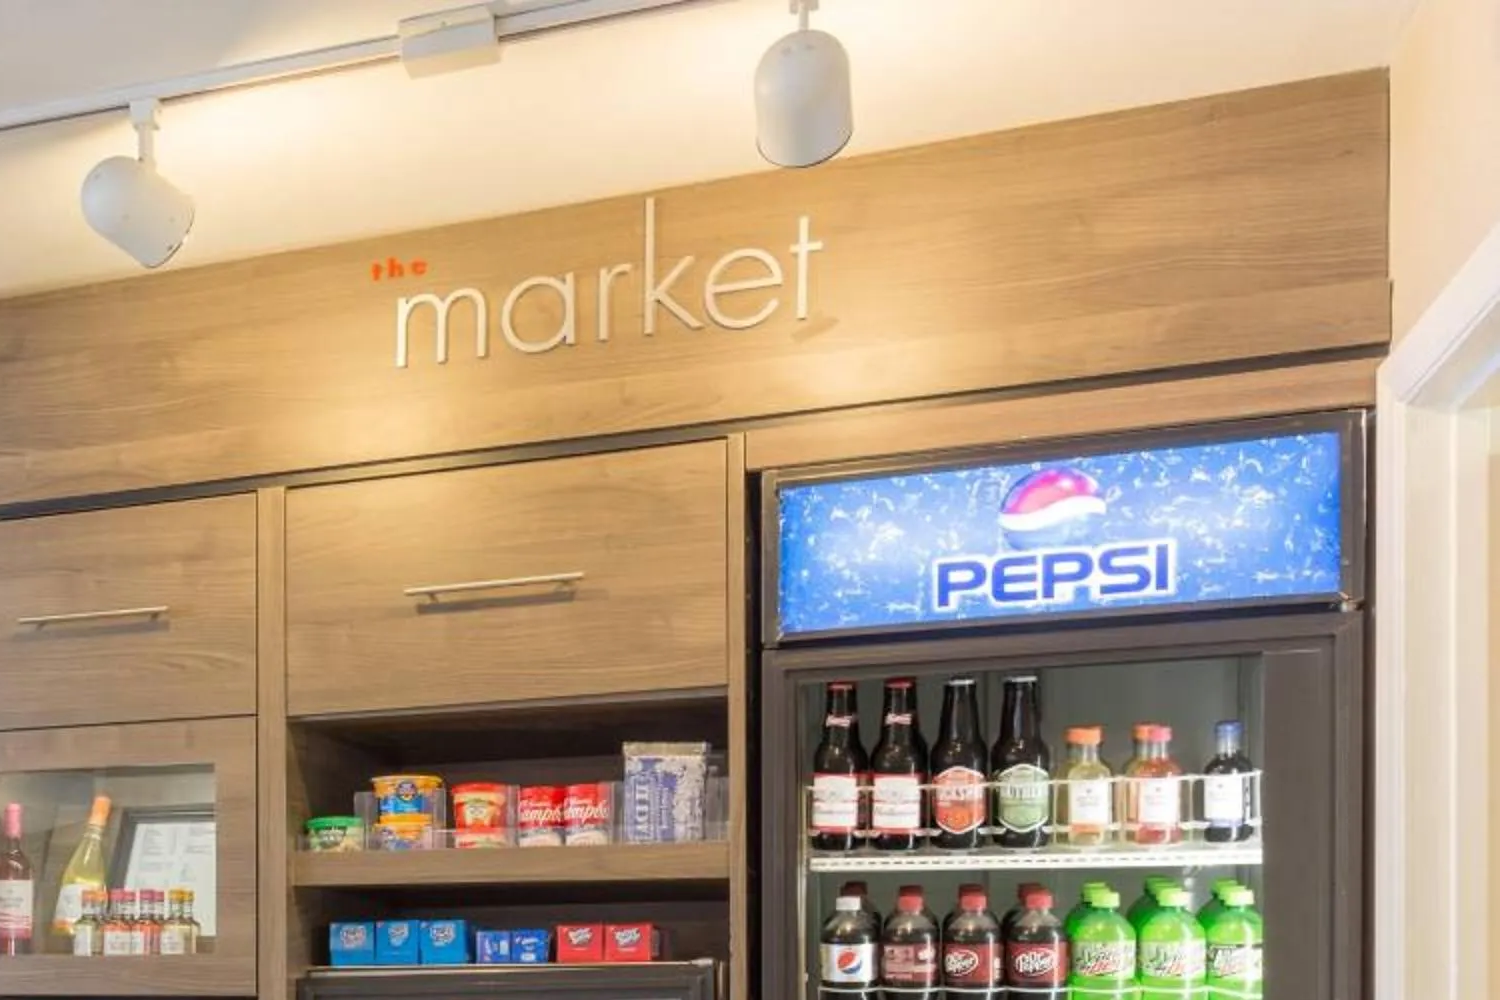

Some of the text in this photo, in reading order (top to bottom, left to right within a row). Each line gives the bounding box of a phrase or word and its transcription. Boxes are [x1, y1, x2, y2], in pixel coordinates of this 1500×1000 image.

[371, 256, 428, 282] the
[395, 197, 824, 369] market
[935, 542, 1171, 609] PEPSI
